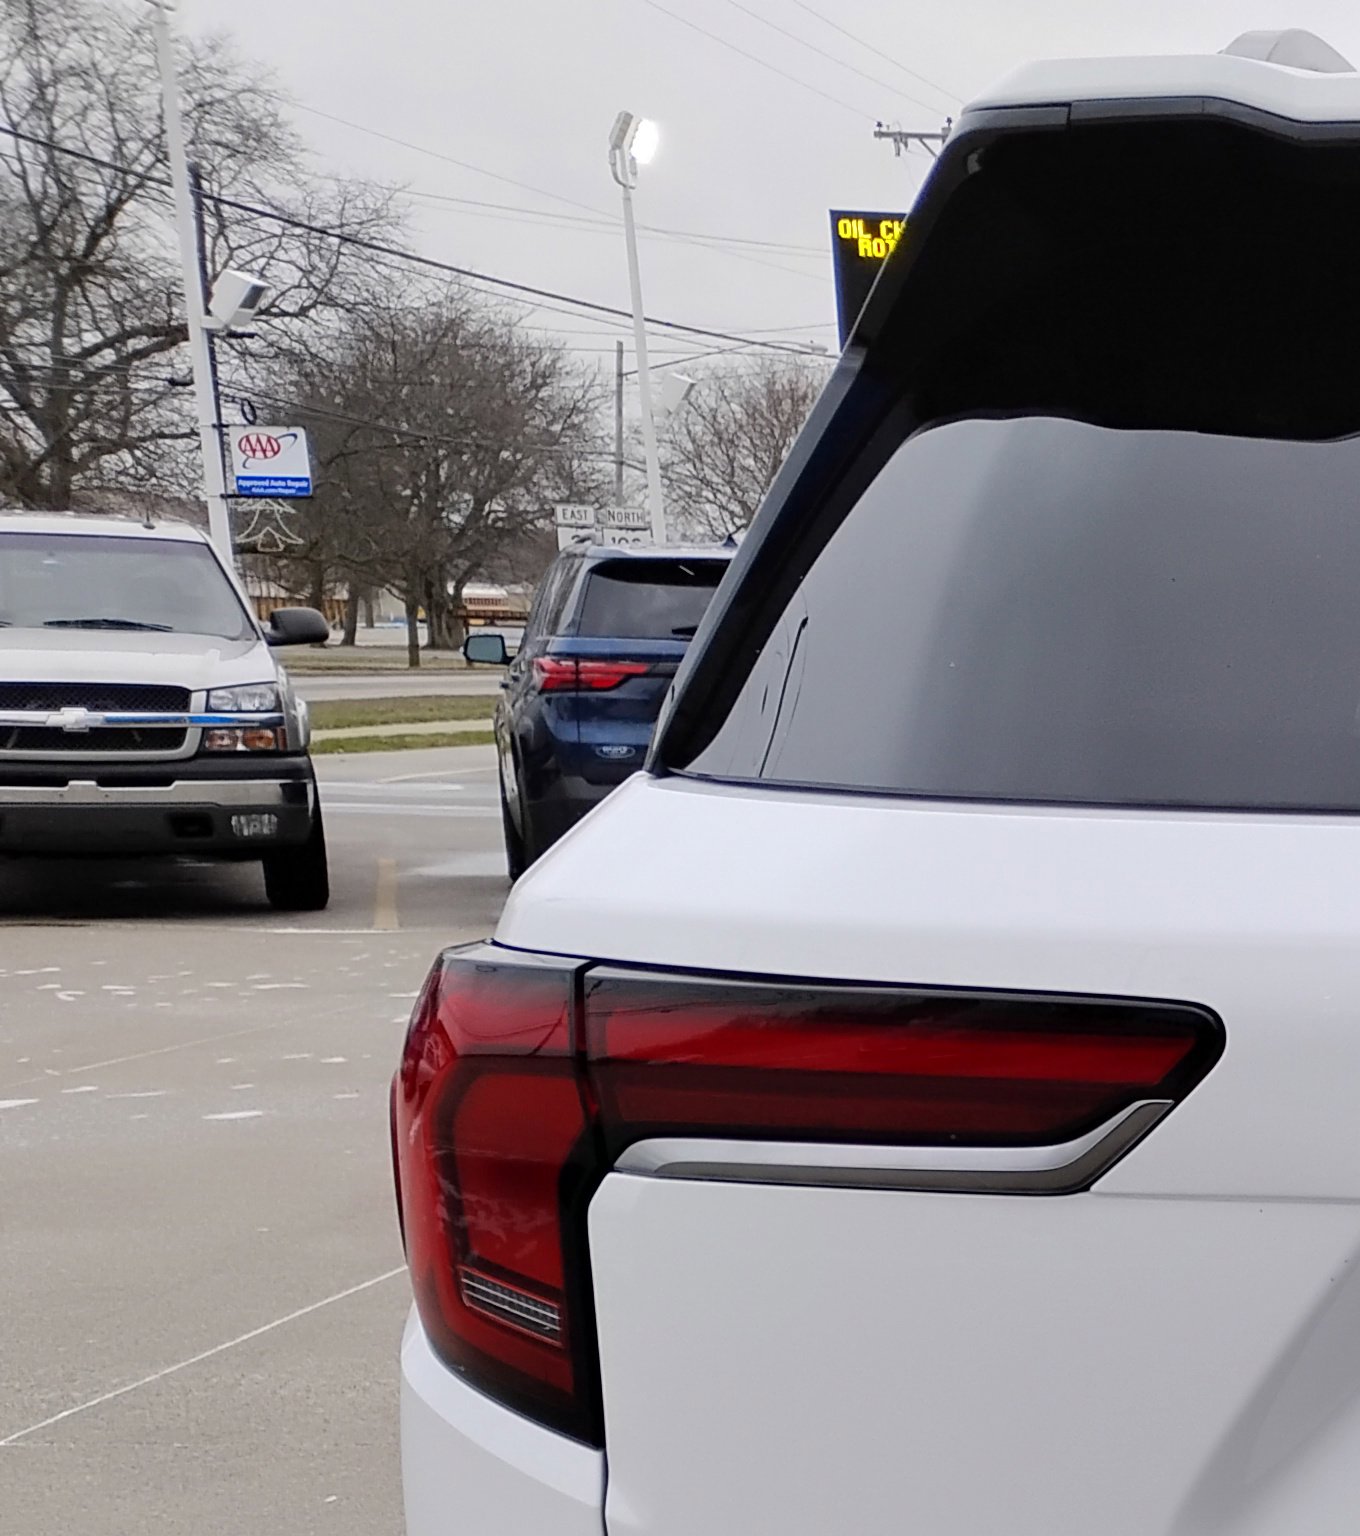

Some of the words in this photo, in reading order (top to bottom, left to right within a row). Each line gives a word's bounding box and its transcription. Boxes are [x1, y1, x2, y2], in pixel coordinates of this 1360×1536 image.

[838, 218, 872, 239] OIL
[241, 433, 279, 459] AAA
[562, 508, 588, 521] EAST
[607, 510, 643, 523] NORTH
